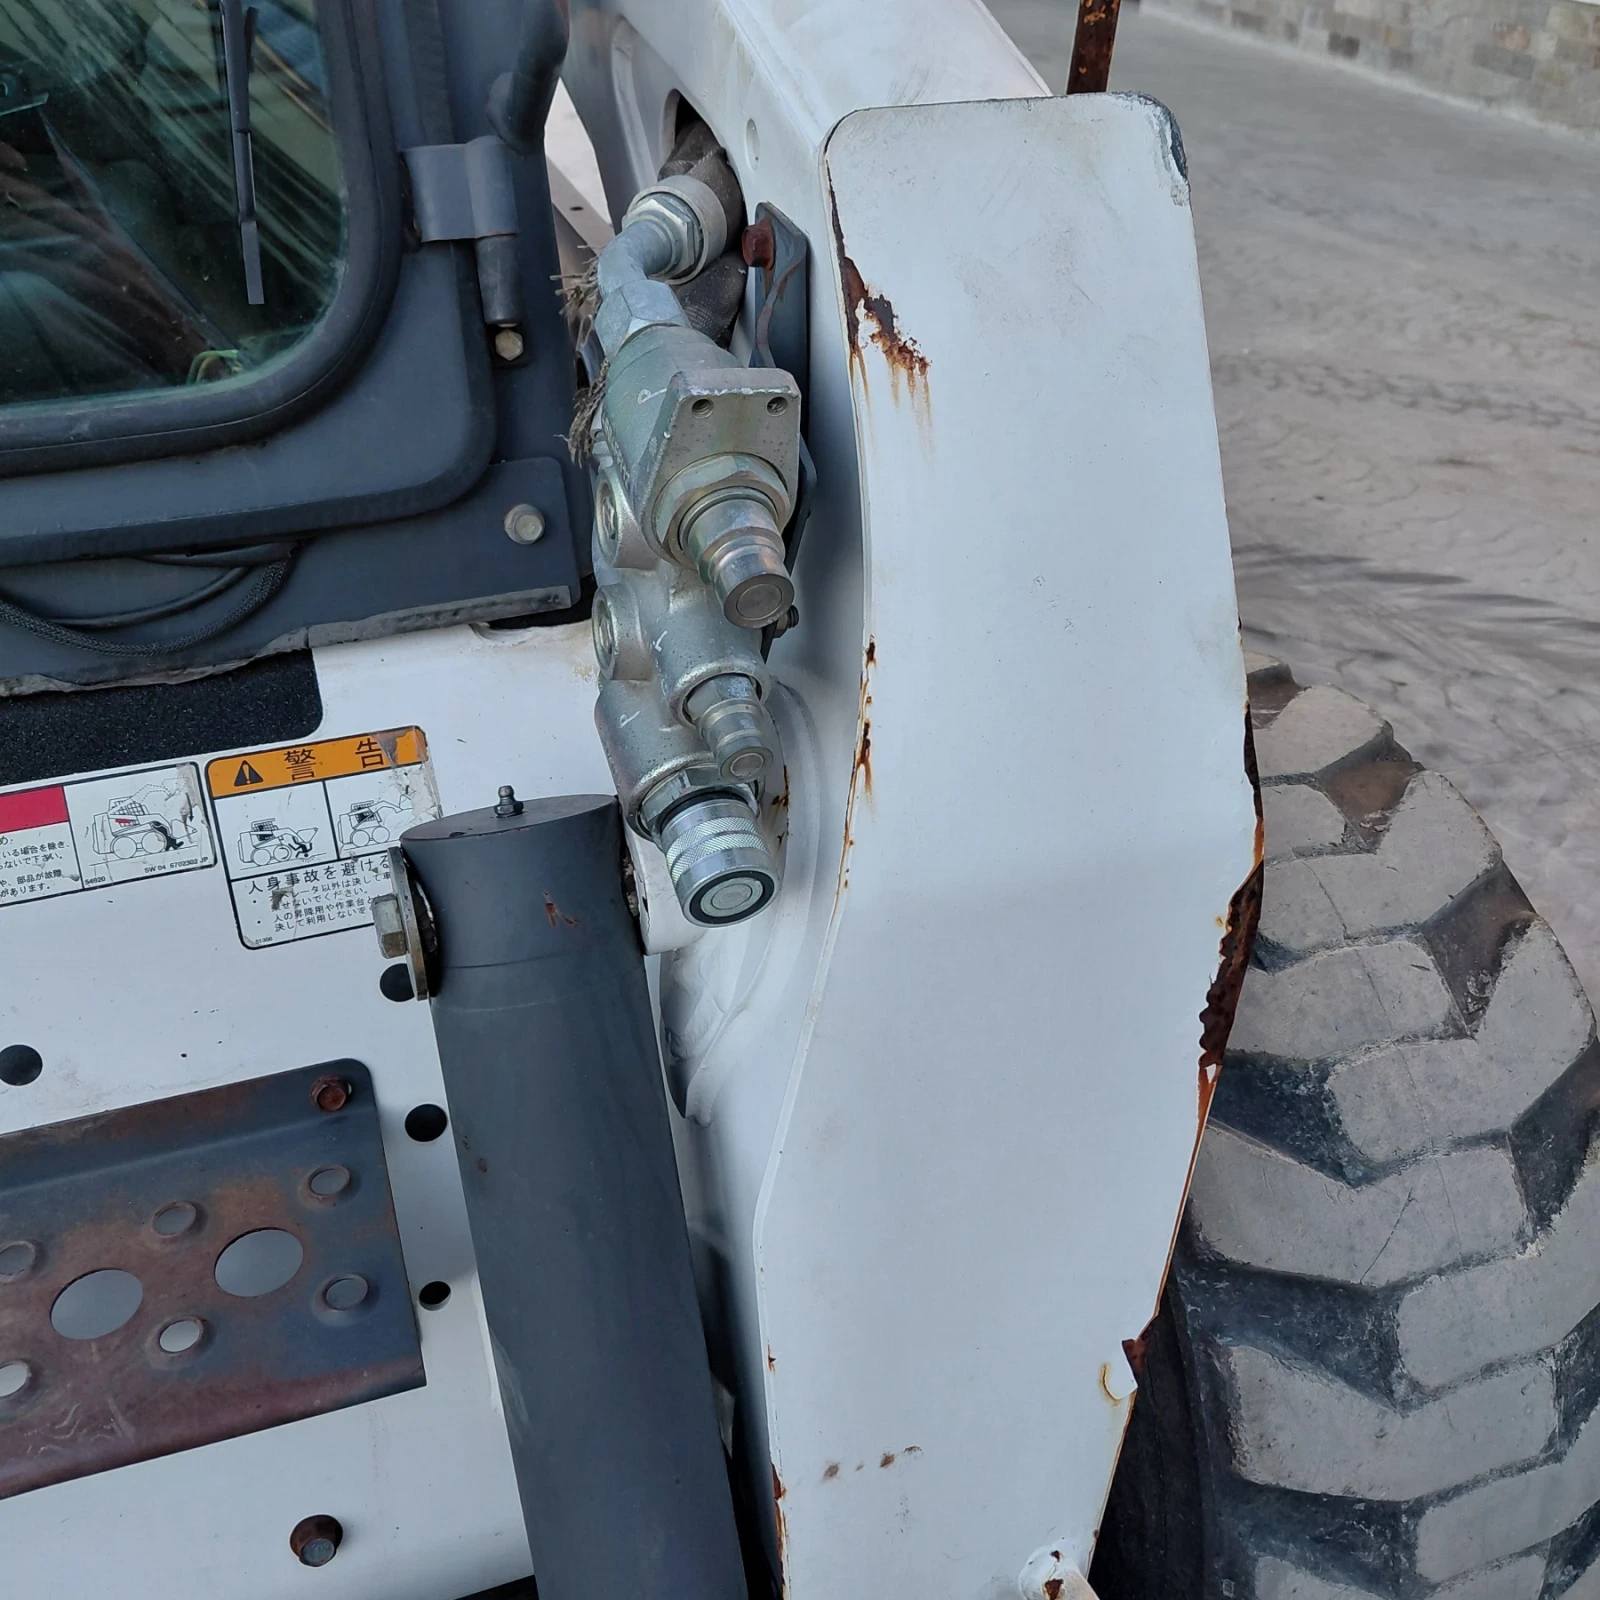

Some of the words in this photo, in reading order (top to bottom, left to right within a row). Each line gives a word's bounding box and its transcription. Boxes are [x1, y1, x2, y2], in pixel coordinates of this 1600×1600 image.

[0, 840, 70, 859] いる場合を除き、
[144, 866, 156, 874] SW
[199, 856, 209, 864] JP
